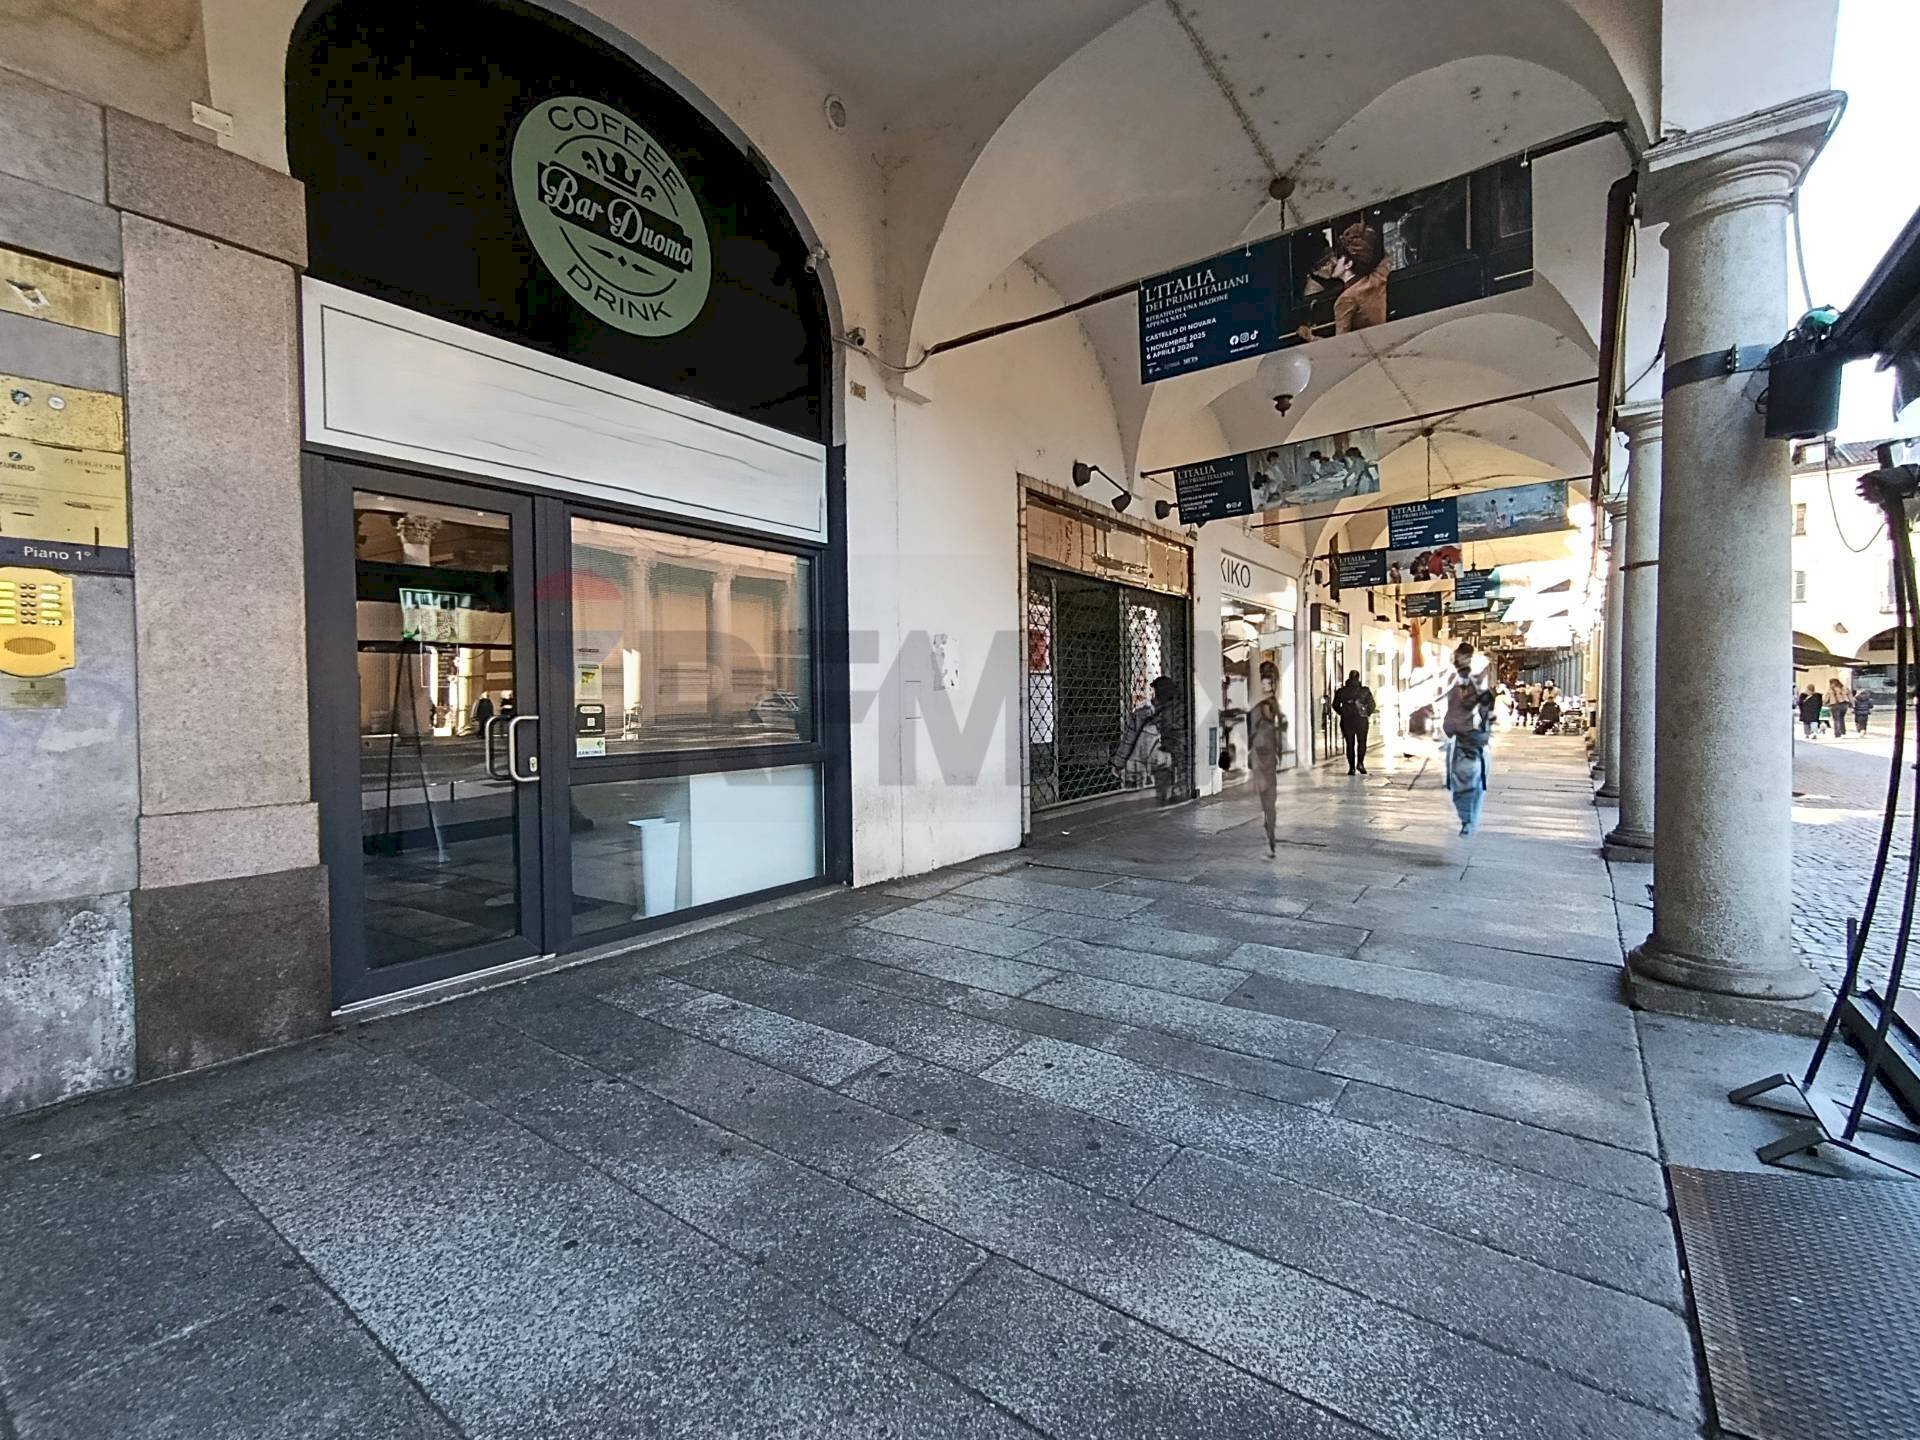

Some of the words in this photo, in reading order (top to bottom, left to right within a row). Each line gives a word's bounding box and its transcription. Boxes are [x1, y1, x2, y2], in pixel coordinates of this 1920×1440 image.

[548, 106, 684, 196] COFFEE
[540, 165, 604, 222] Bar
[607, 198, 693, 265] Duomo
[566, 264, 672, 321] DRINK
[1145, 269, 1216, 302] L'ITALIA
[1145, 300, 1163, 313] DEI
[1166, 289, 1196, 307] PRIMI
[1200, 274, 1249, 297] ITALIANI
[1183, 302, 1198, 312] UNA
[1199, 293, 1229, 307] NAZIONE
[1145, 328, 1178, 342] CASTELLO
[1188, 317, 1217, 330] NOVARA
[1151, 336, 1187, 351] NOVEMBRE
[1189, 331, 1206, 341] 2025
[1152, 347, 1176, 358] APRILE
[1177, 342, 1194, 352] 2026
[23, 546, 69, 560] Piano
